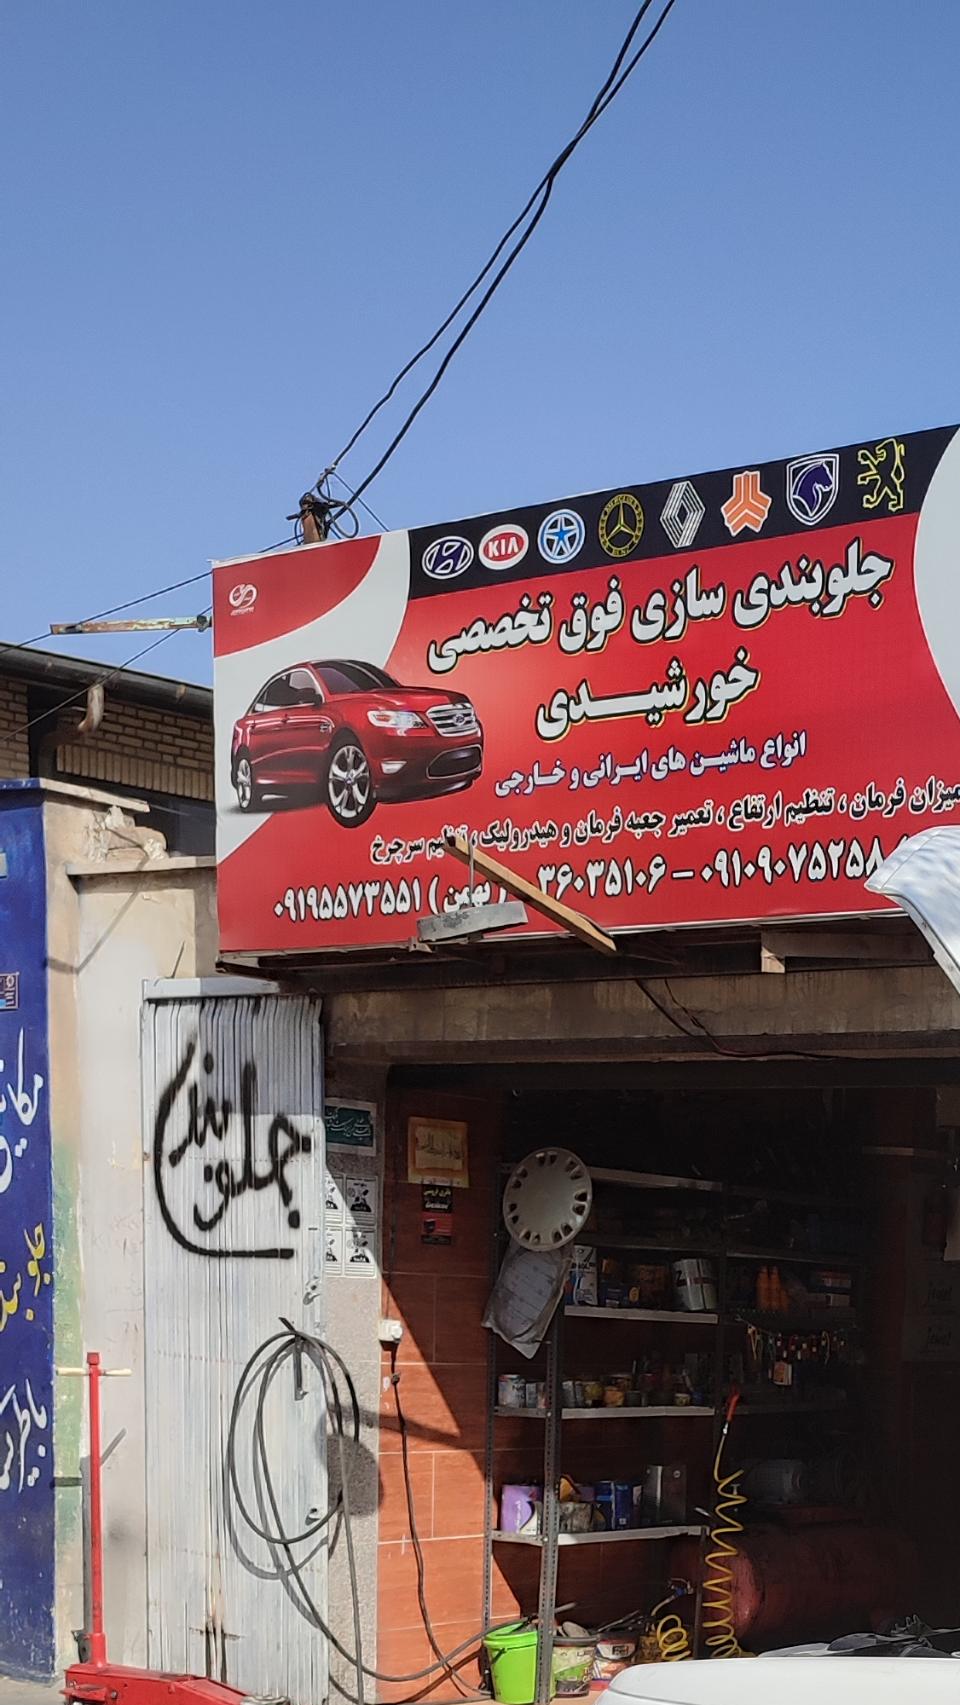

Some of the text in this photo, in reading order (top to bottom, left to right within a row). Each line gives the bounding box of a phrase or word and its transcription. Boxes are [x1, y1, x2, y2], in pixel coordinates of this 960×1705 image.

[488, 536, 519, 558] KIA
[427, 538, 893, 673] جلوبندی سازی فوق تخصصی
[494, 730, 806, 798] انواع ماشین های ایرانی و خارجی
[574, 805, 622, 845] فرمان
[625, 809, 667, 840] جعبه
[668, 801, 713, 838] تعمیر
[785, 786, 836, 825] تنظیم
[561, 822, 571, 846] و
[273, 876, 421, 922] ۰۹۱۹۵۵۷۳۵۵۱
